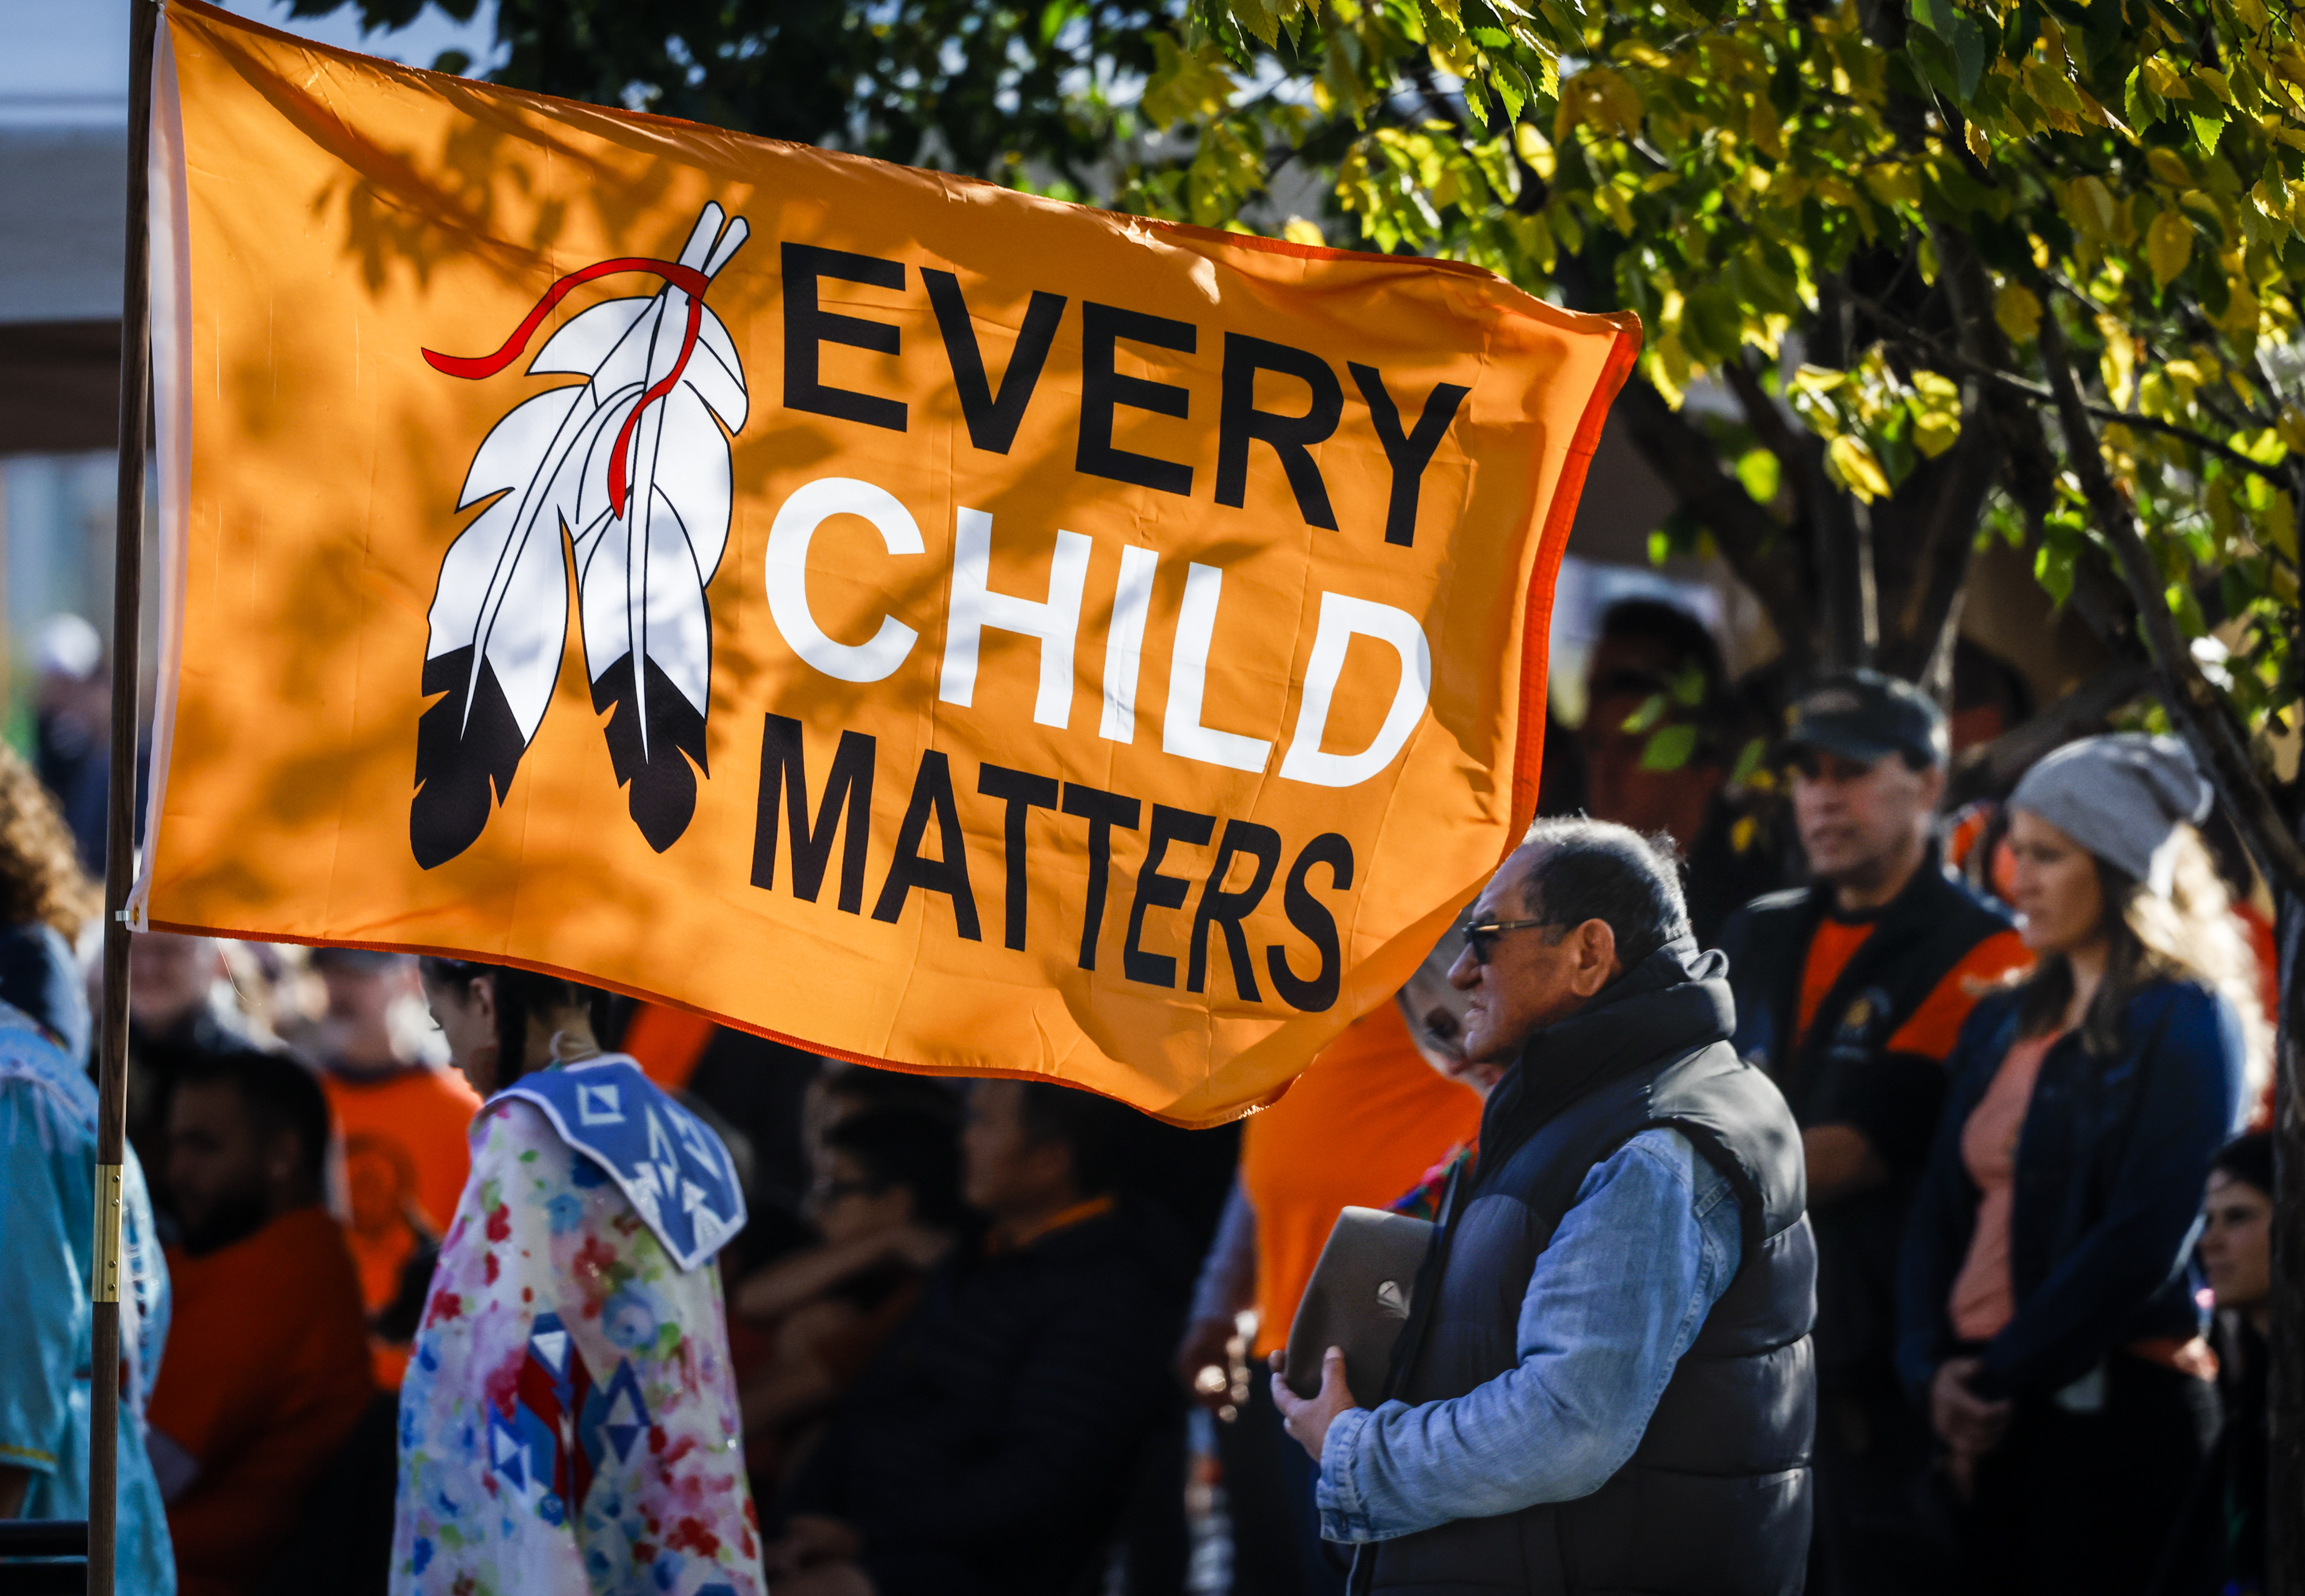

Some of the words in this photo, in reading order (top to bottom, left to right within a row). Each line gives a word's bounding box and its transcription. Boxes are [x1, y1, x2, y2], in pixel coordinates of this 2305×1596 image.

[780, 242, 1472, 547] EVERY
[765, 477, 1432, 788] CHILD
[751, 713, 1354, 1012] MATTERS
